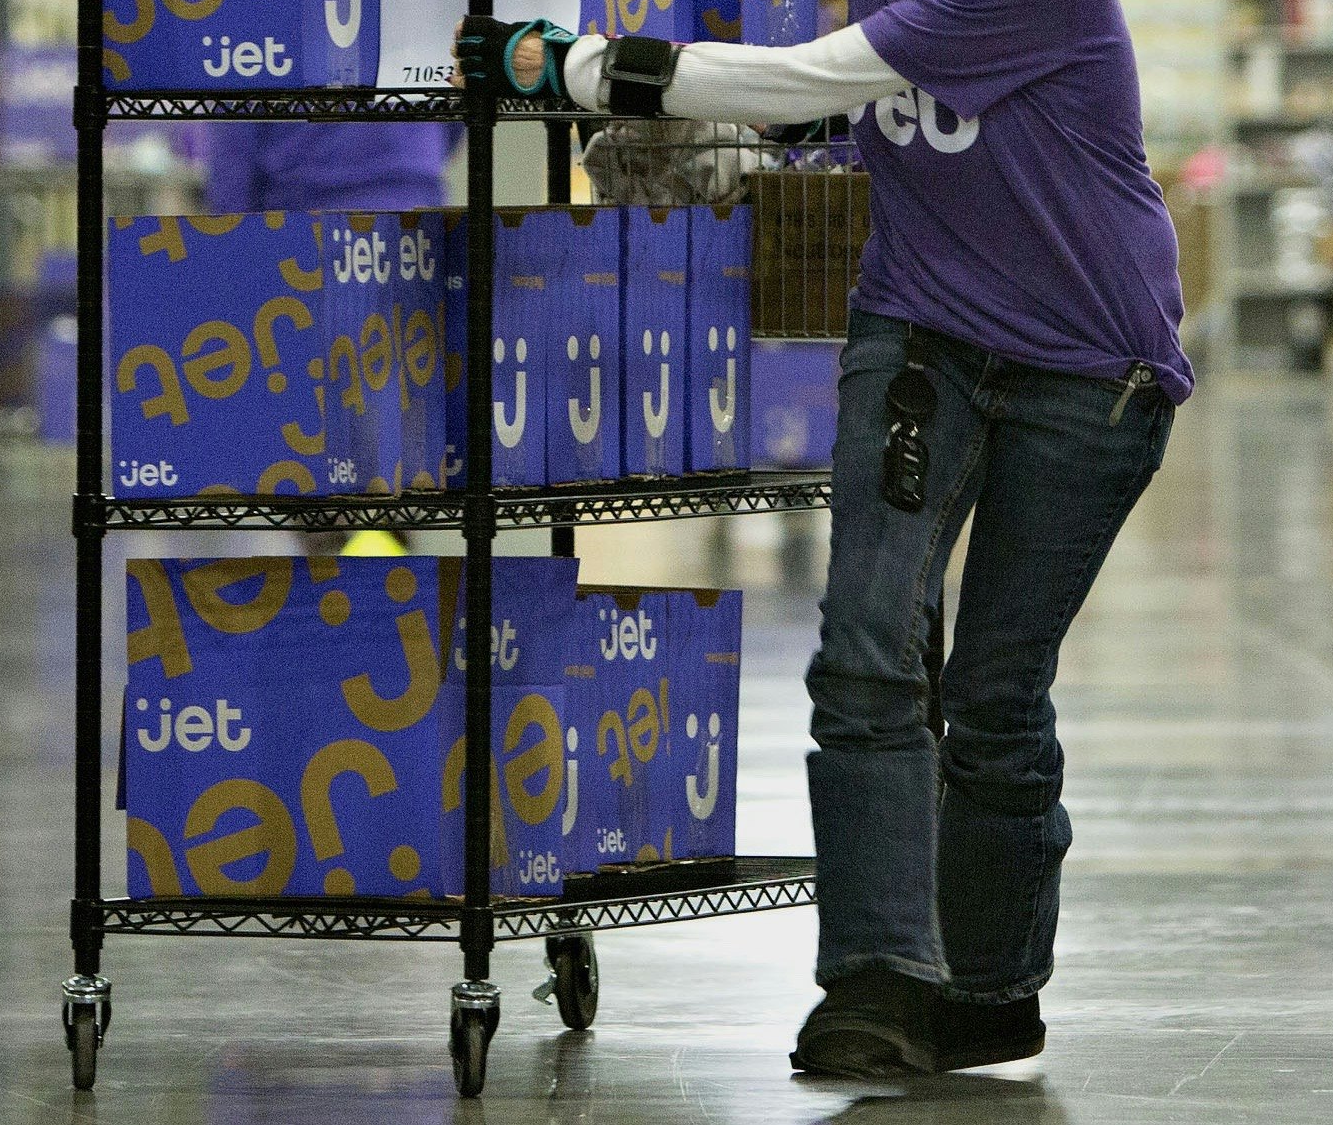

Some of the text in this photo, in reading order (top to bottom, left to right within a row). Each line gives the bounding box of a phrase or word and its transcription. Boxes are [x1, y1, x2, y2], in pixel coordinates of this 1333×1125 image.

[202, 35, 293, 77] jet
[333, 228, 390, 284] jet
[399, 228, 435, 281] et
[116, 296, 315, 426] jet
[120, 459, 178, 487] jet
[328, 458, 357, 484] jet
[600, 609, 657, 660] jet
[137, 698, 251, 752] jet
[598, 680, 668, 787] et
[597, 828, 626, 853] jet
[519, 850, 560, 883] jet
